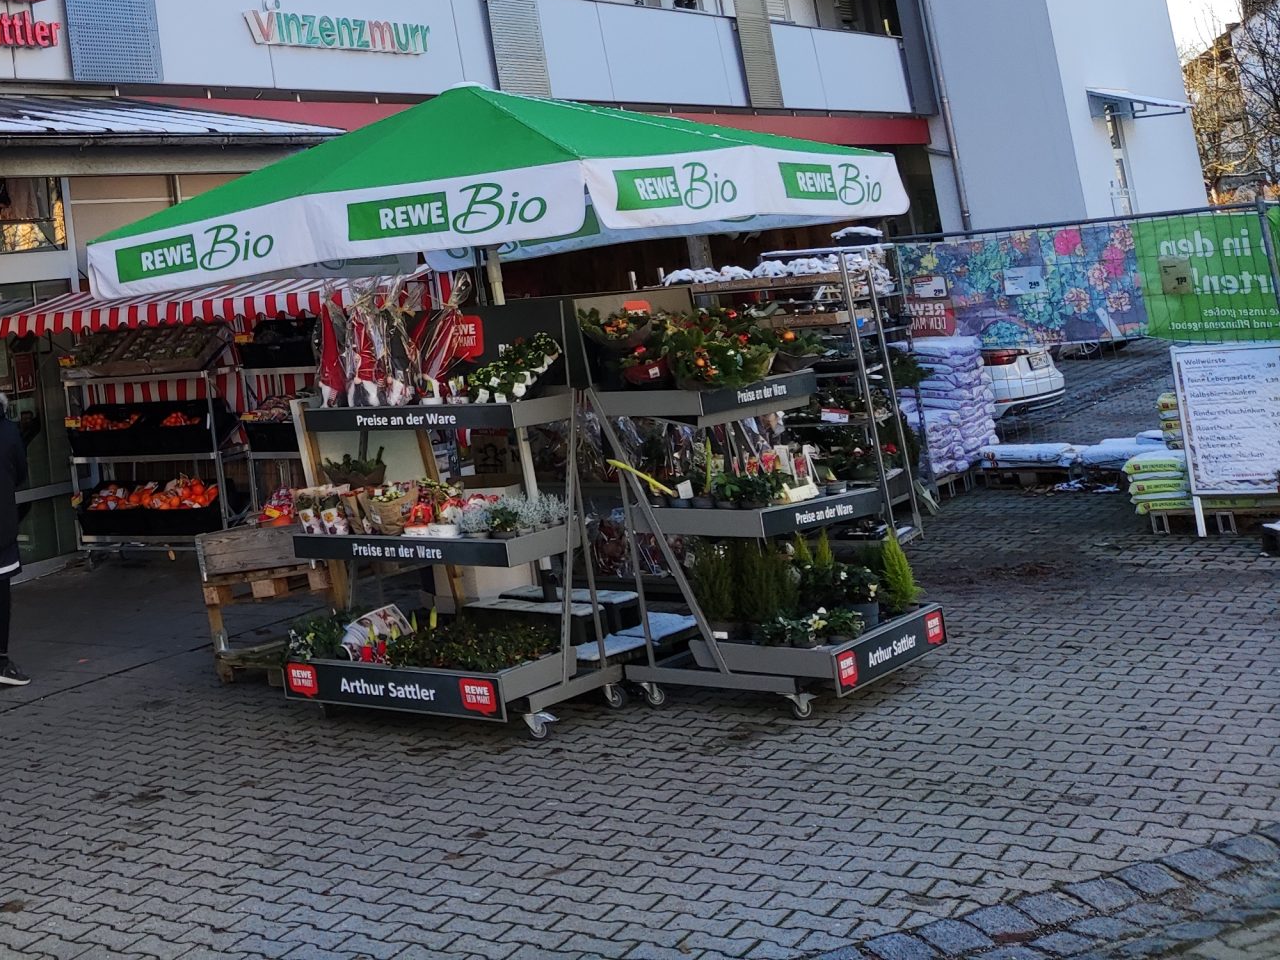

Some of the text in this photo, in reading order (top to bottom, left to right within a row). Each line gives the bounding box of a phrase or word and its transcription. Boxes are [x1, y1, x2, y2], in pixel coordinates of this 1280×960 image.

[634, 162, 737, 210] REWE Bio
[795, 163, 882, 205] REWE Bio
[378, 182, 547, 235] REWE Bio
[140, 223, 274, 272] REWE Bio
[737, 390, 756, 404] Preise
[756, 390, 763, 399] an
[763, 385, 773, 399] der
[356, 412, 457, 426] Preise an der Ware
[795, 503, 853, 525] Preise an der Ware
[352, 543, 442, 560] Preise an der Ware
[868, 634, 917, 668] Arthur Sattler
[291, 669, 313, 679] REWE
[340, 677, 436, 701] Arthur Sattler
[464, 685, 490, 695] REWE
